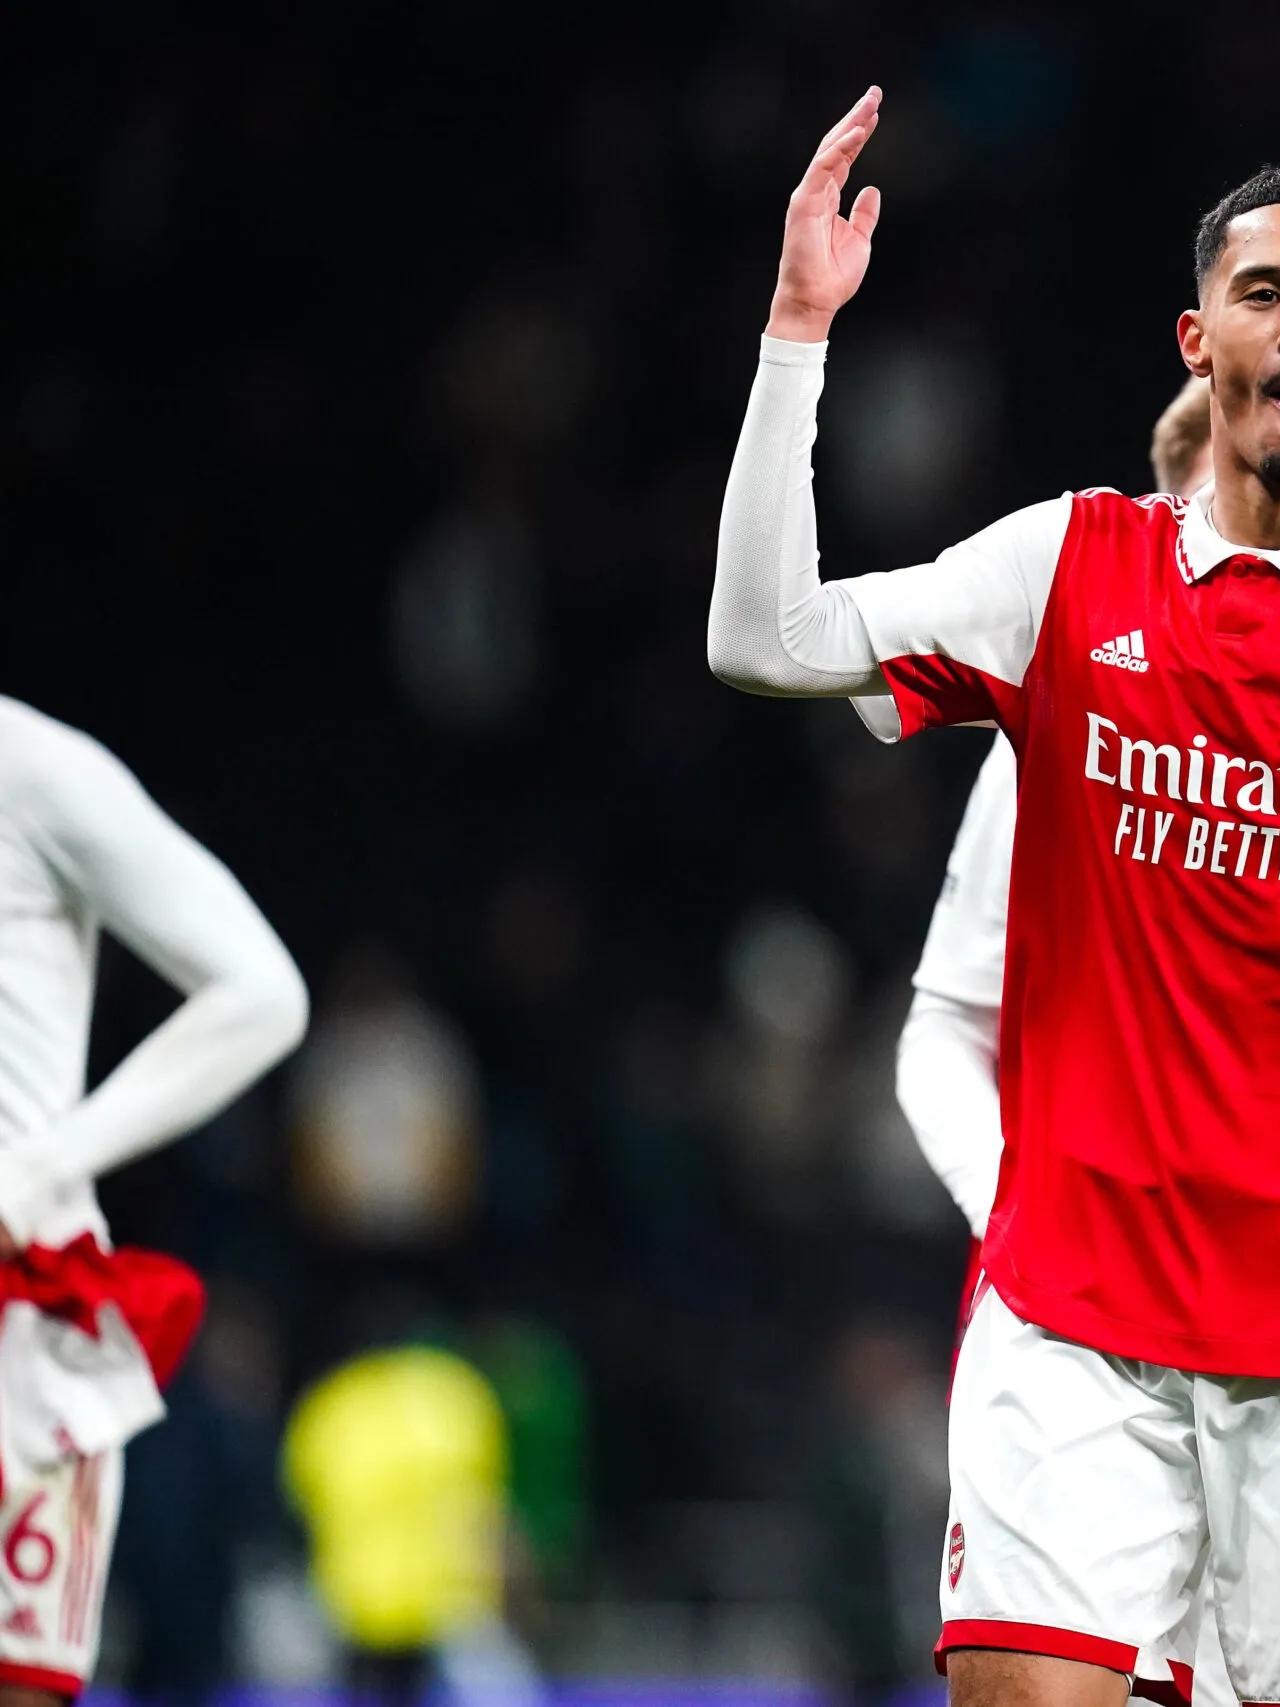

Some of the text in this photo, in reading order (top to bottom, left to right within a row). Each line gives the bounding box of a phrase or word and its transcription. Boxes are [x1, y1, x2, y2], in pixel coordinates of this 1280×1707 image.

[1090, 648, 1149, 673] adidas
[1114, 803, 1174, 865] FLY
[5, 1490, 55, 1586] 6
